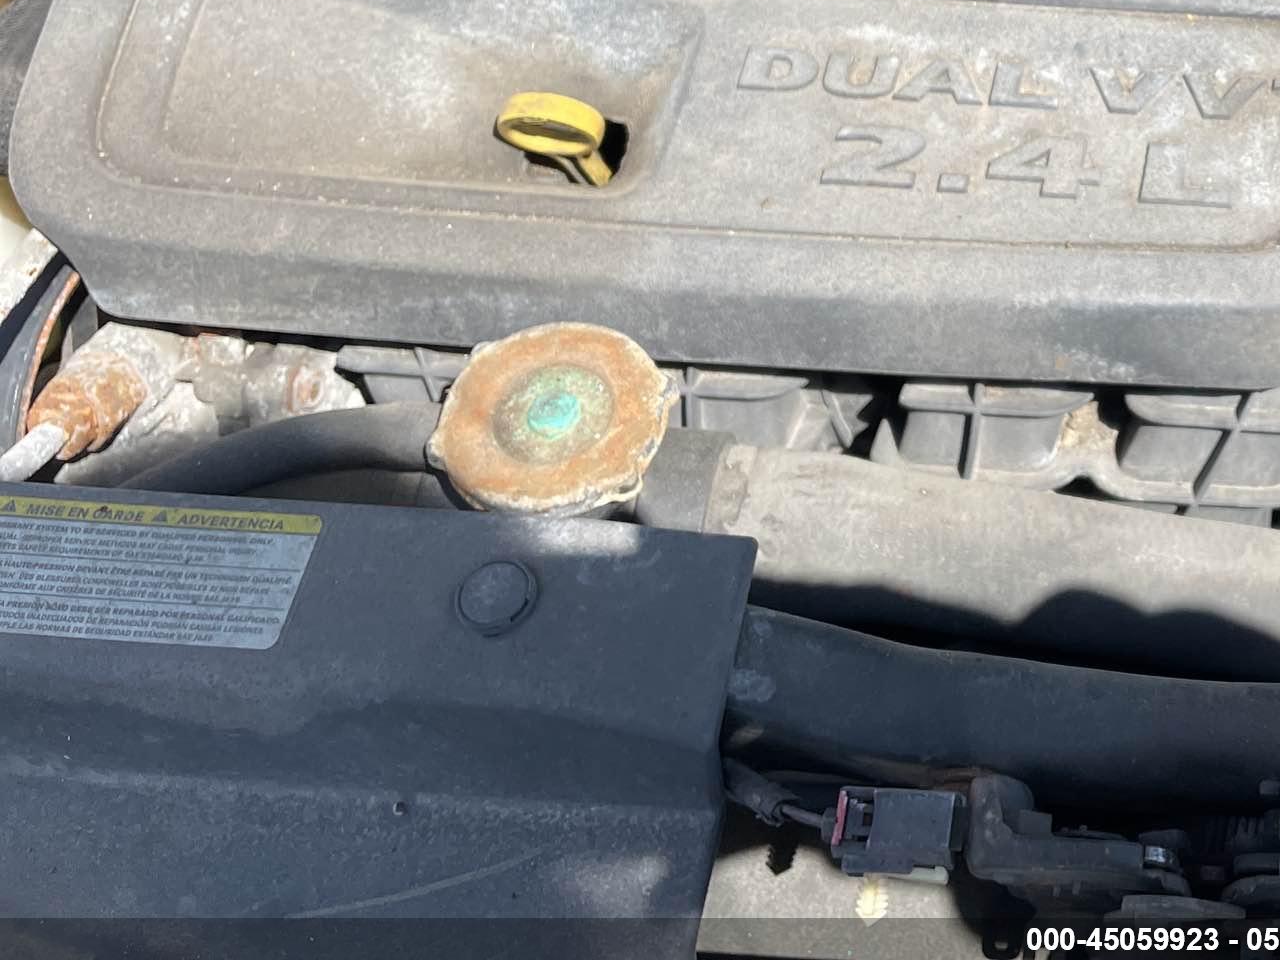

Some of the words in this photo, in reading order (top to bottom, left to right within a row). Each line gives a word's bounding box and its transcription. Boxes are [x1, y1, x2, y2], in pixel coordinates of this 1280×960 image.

[737, 45, 1058, 110] DUAL
[26, 503, 66, 517] MISE
[68, 506, 90, 518] EN
[93, 508, 144, 522] GARDE
[176, 513, 285, 530] ADVERTENCIA
